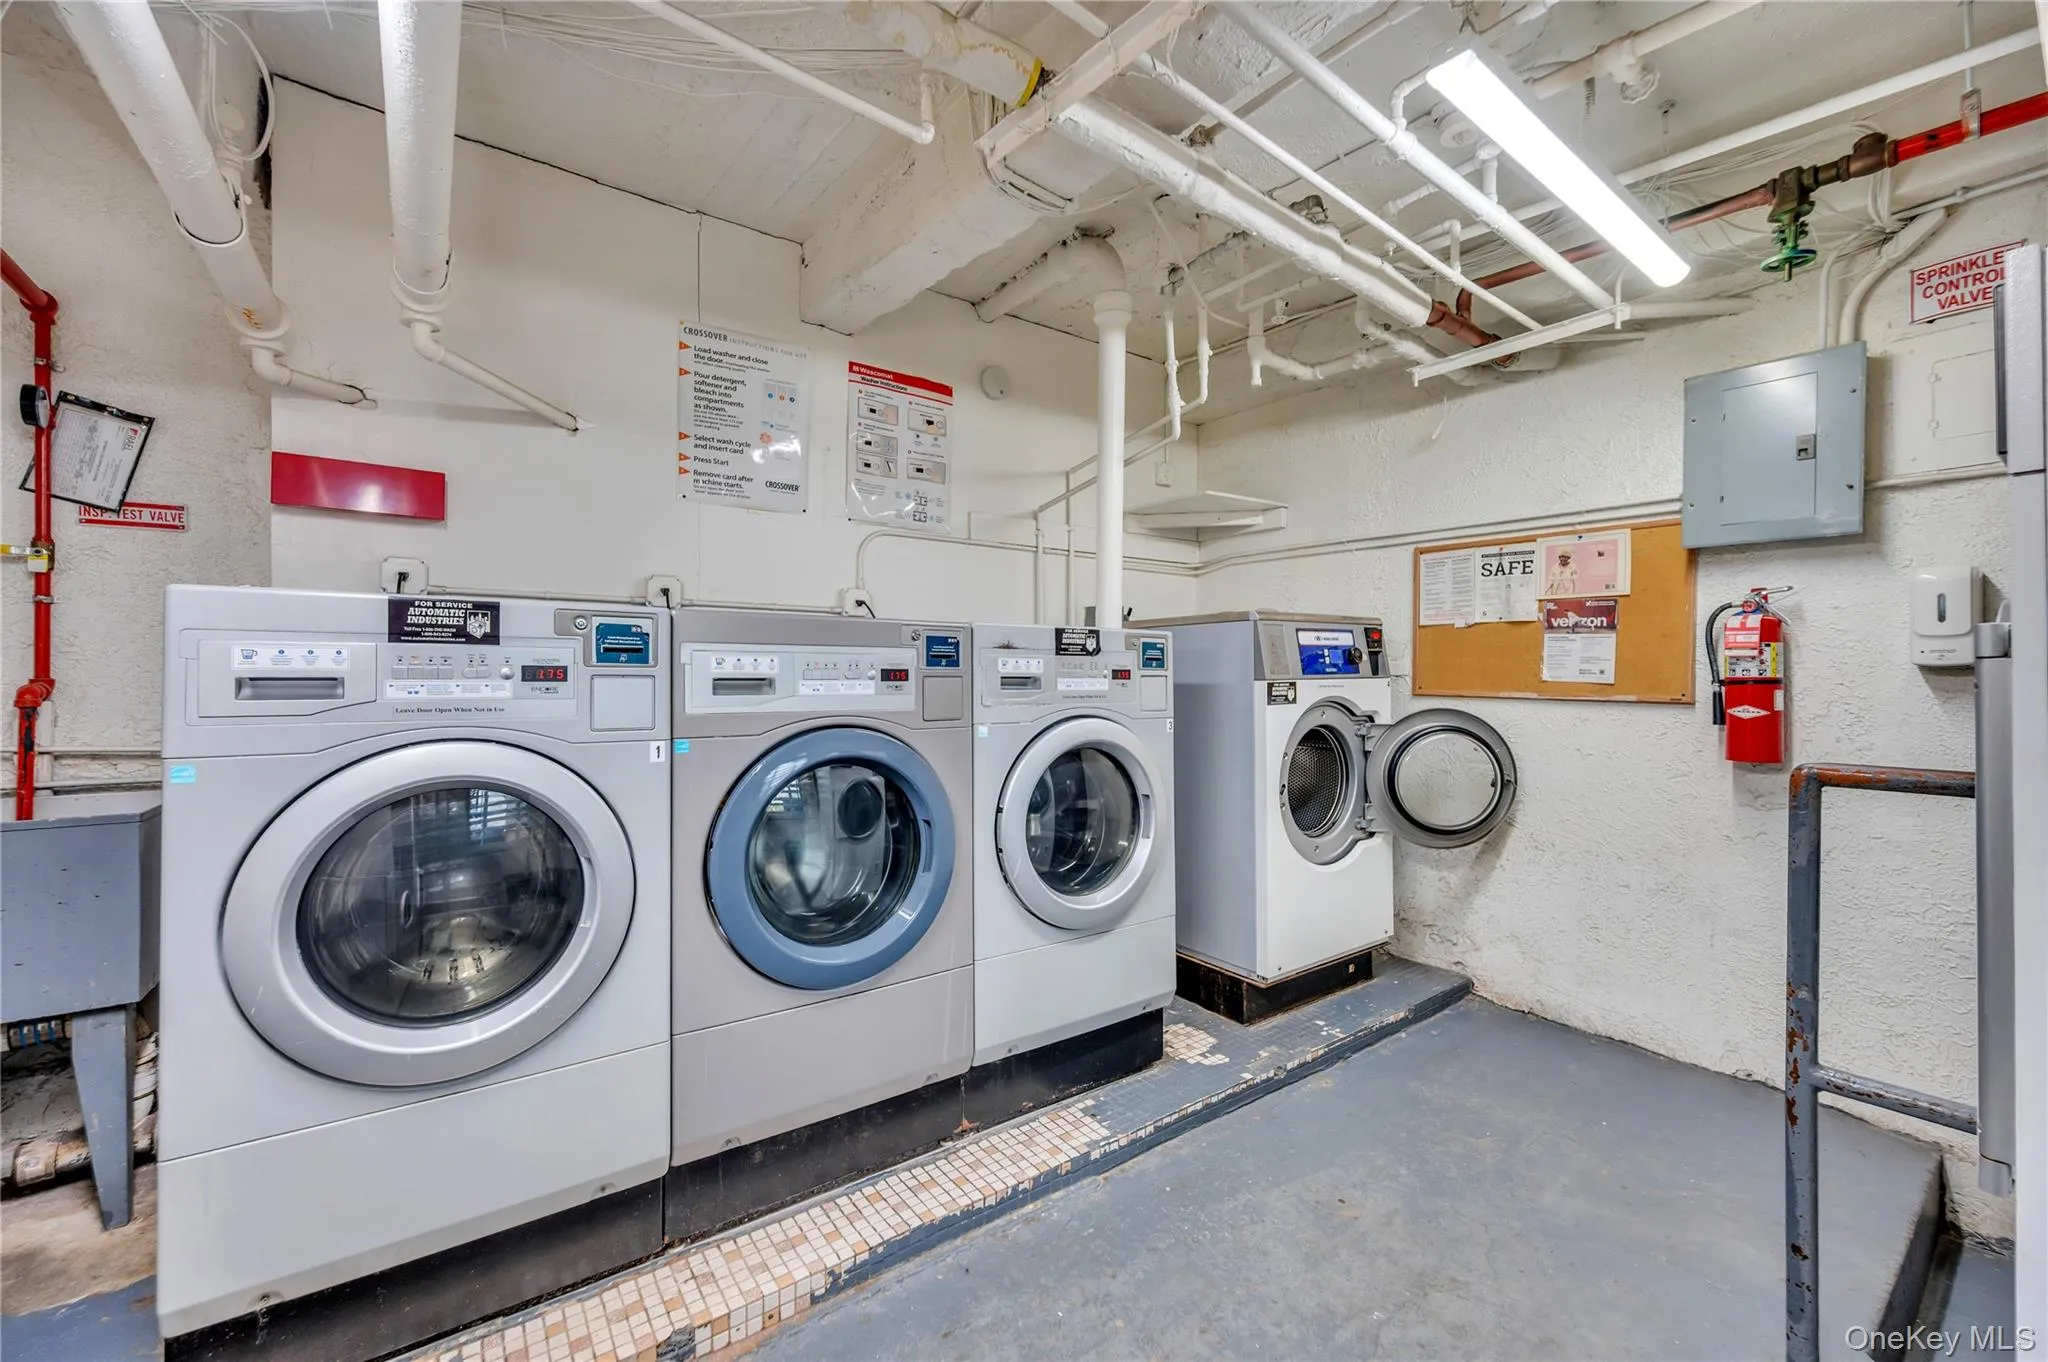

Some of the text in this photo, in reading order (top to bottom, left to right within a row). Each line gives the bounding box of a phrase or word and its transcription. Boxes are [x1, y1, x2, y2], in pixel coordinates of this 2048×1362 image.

[1916, 250, 2004, 286] SPRINKLE
[1937, 286, 1993, 310] VALVE
[683, 327, 728, 342] CROSSOVER
[693, 345, 768, 365] Load washer and close
[706, 355, 724, 364] door.
[694, 371, 710, 380] Pour
[860, 367, 894, 380] Wascomat
[860, 375, 879, 384] Washer
[693, 379, 723, 391] softener
[693, 386, 732, 398] bleach into
[693, 395, 744, 408] compartments
[693, 433, 751, 448] Select wash cycle
[708, 445, 728, 453] insert
[729, 447, 744, 455] card
[693, 455, 729, 466] Press Start
[693, 469, 754, 483] Remove card after
[149, 510, 185, 523] VALVE
[1481, 559, 1534, 577] SAFE
[408, 607, 465, 617] AUTOMATIC
[406, 616, 464, 625] INDUSTRIES
[434, 707, 452, 715] Open
[655, 745, 660, 759] 1
